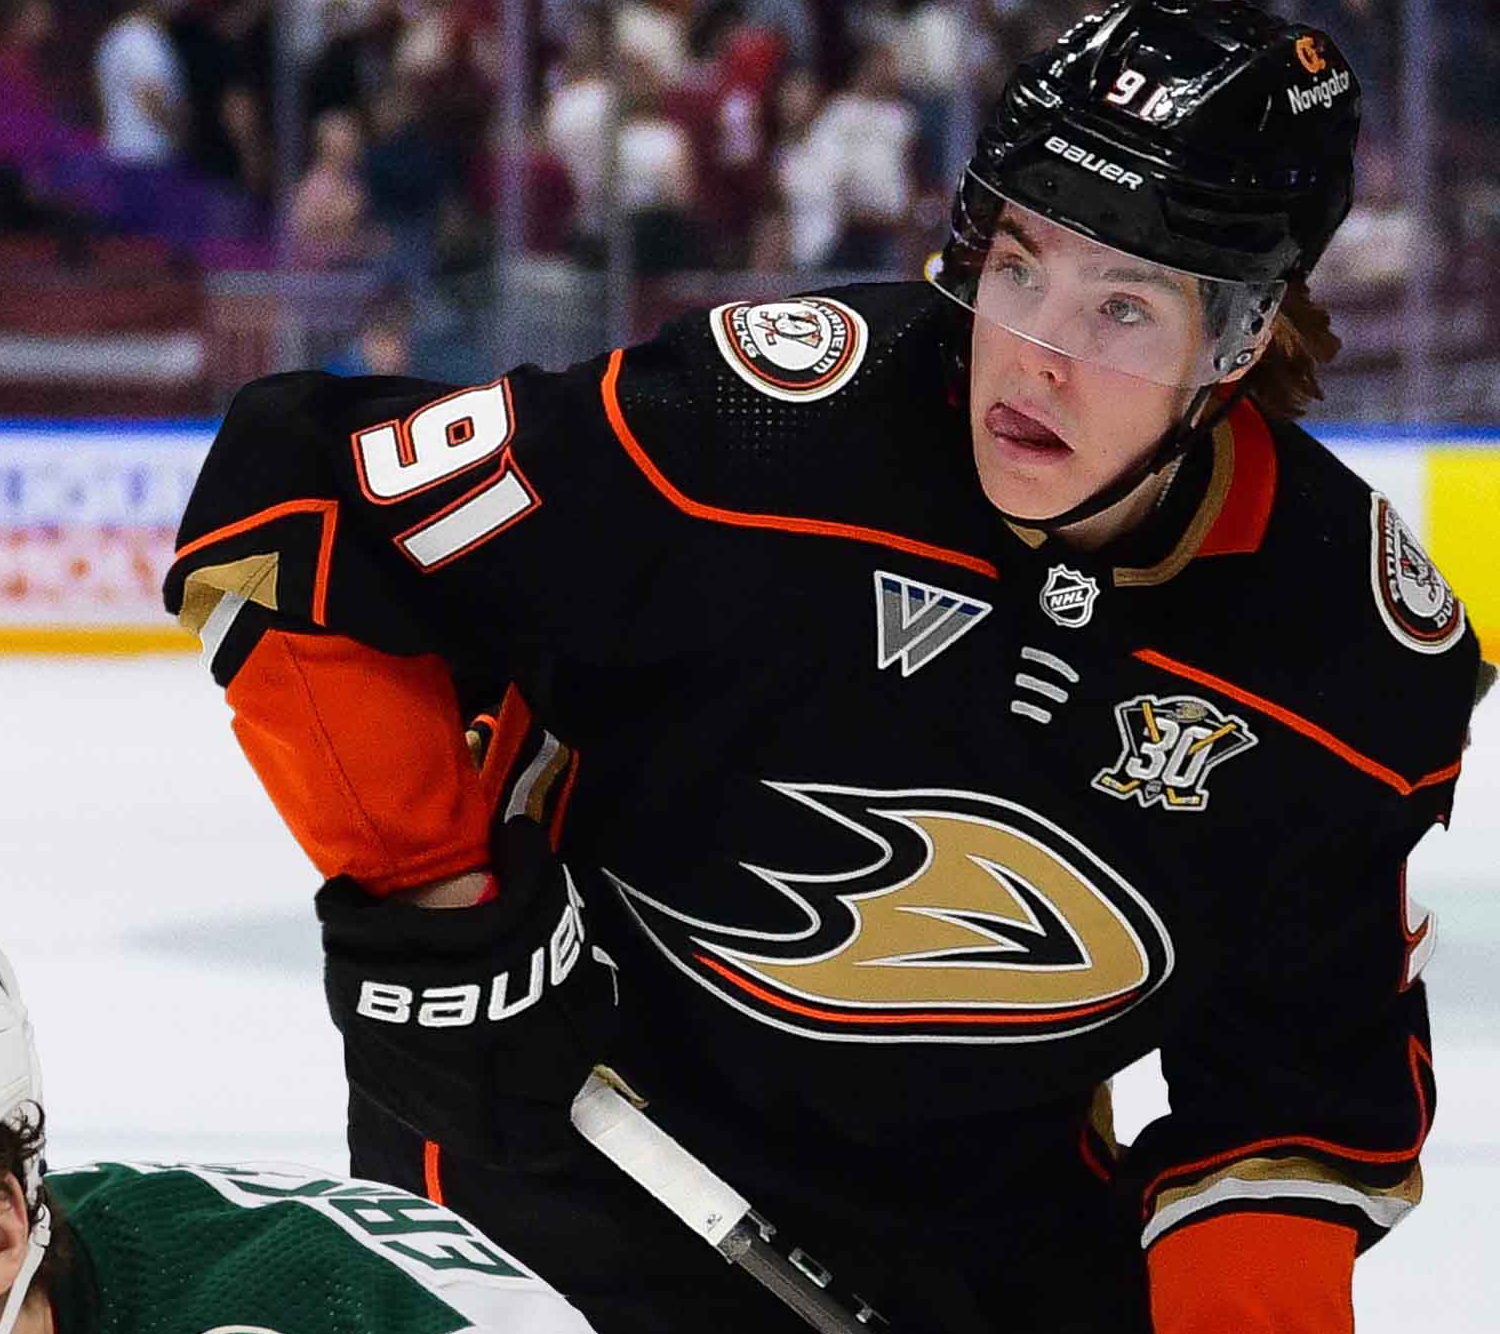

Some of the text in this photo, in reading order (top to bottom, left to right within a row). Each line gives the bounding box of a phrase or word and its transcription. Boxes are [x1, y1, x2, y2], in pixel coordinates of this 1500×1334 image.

[1044, 135, 1144, 191] BAUER
[350, 376, 541, 574] 91
[1050, 591, 1087, 609] NHL
[1127, 717, 1214, 788] 30
